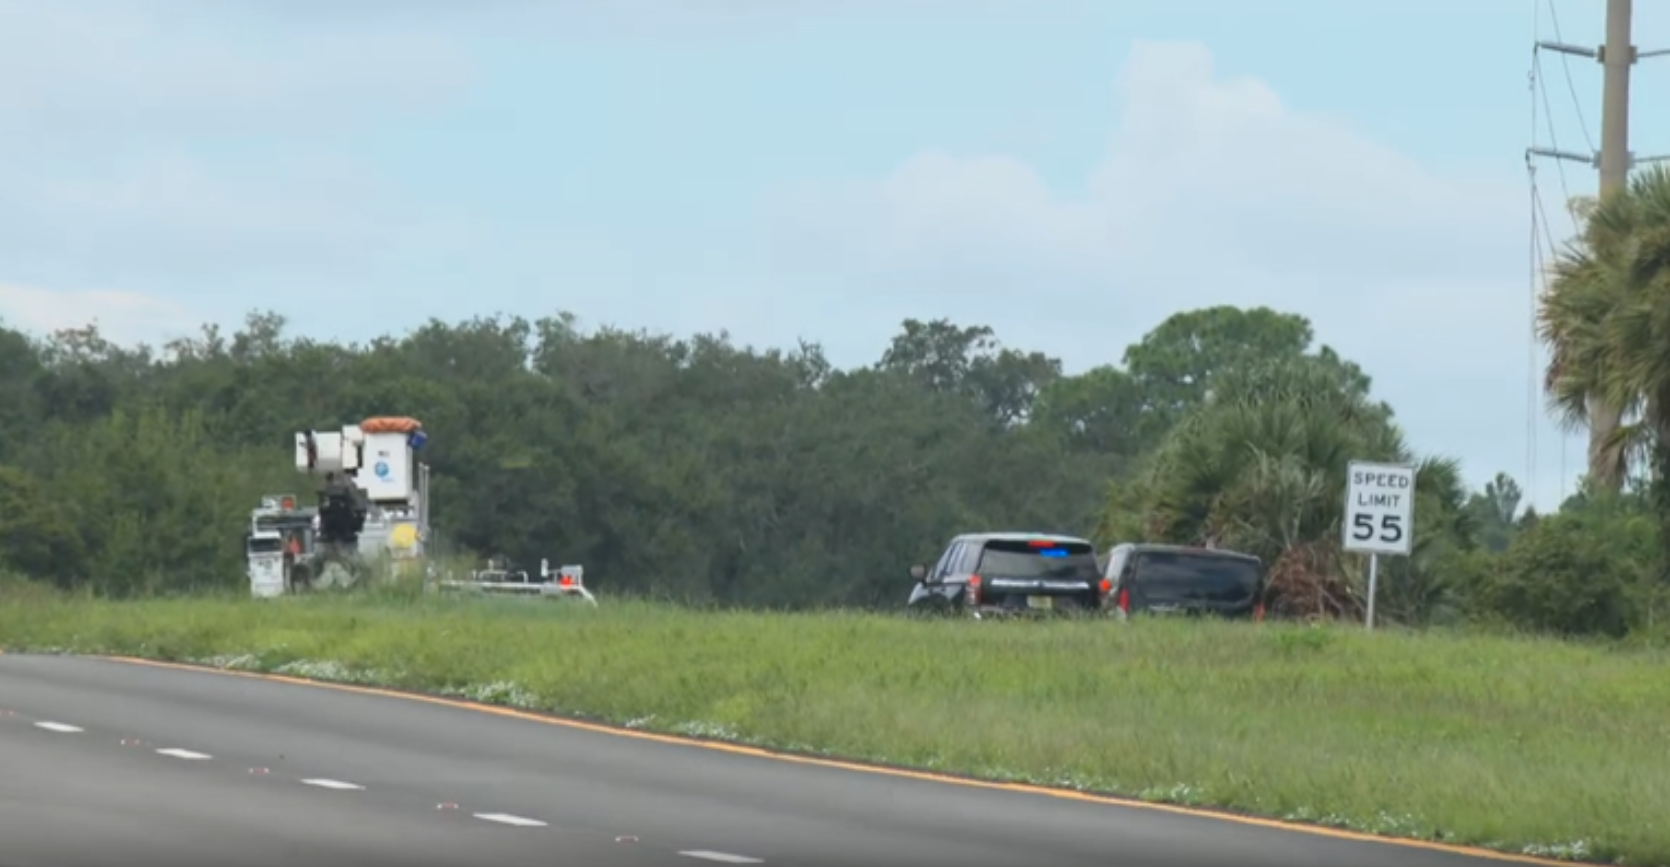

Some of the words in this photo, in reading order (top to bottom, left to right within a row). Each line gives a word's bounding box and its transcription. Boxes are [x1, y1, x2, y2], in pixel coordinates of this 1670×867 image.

[1354, 471, 1408, 489] SPEED
[1358, 492, 1401, 508] LIMIT
[1353, 512, 1402, 543] 55
